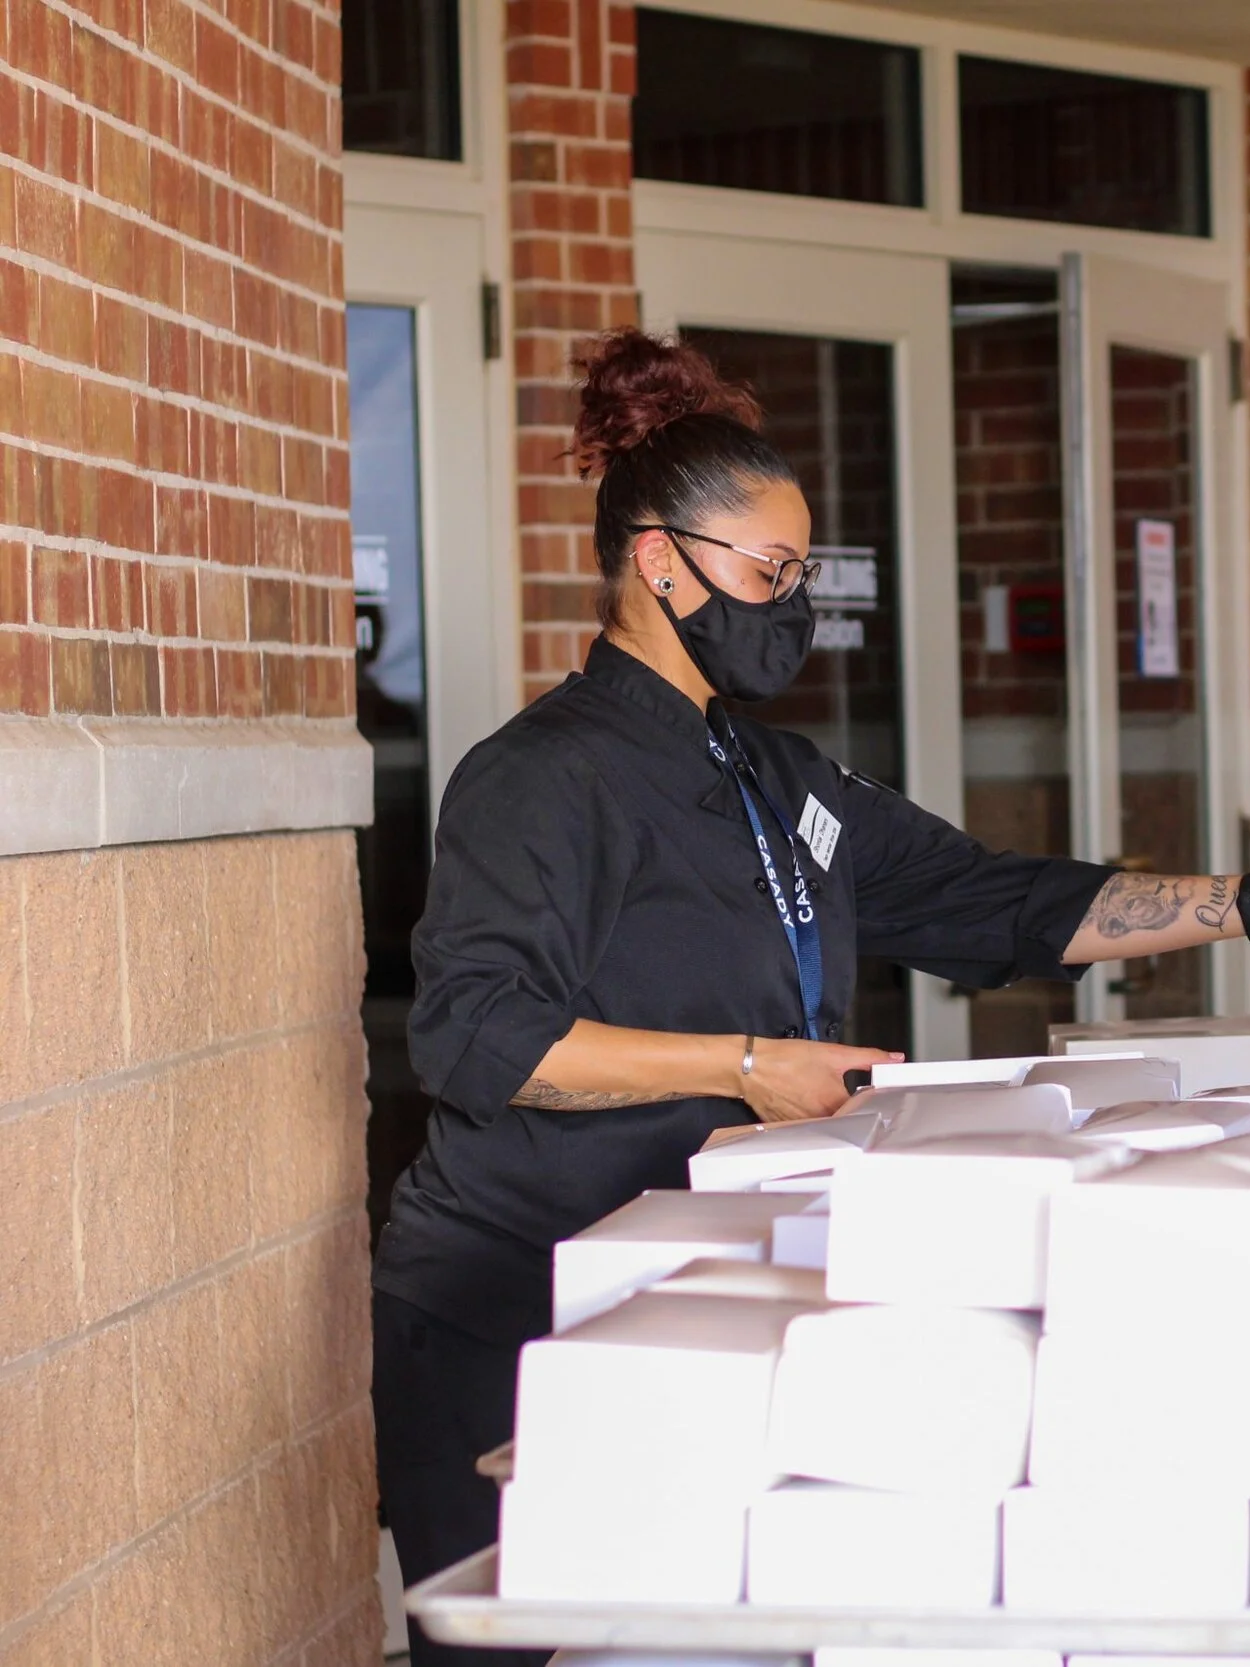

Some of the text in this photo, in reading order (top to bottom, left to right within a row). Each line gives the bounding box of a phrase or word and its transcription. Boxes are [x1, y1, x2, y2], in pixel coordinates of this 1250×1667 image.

[757, 834, 795, 929] CASADY
[790, 841, 814, 924] CASA
[1195, 875, 1237, 933] Quee
